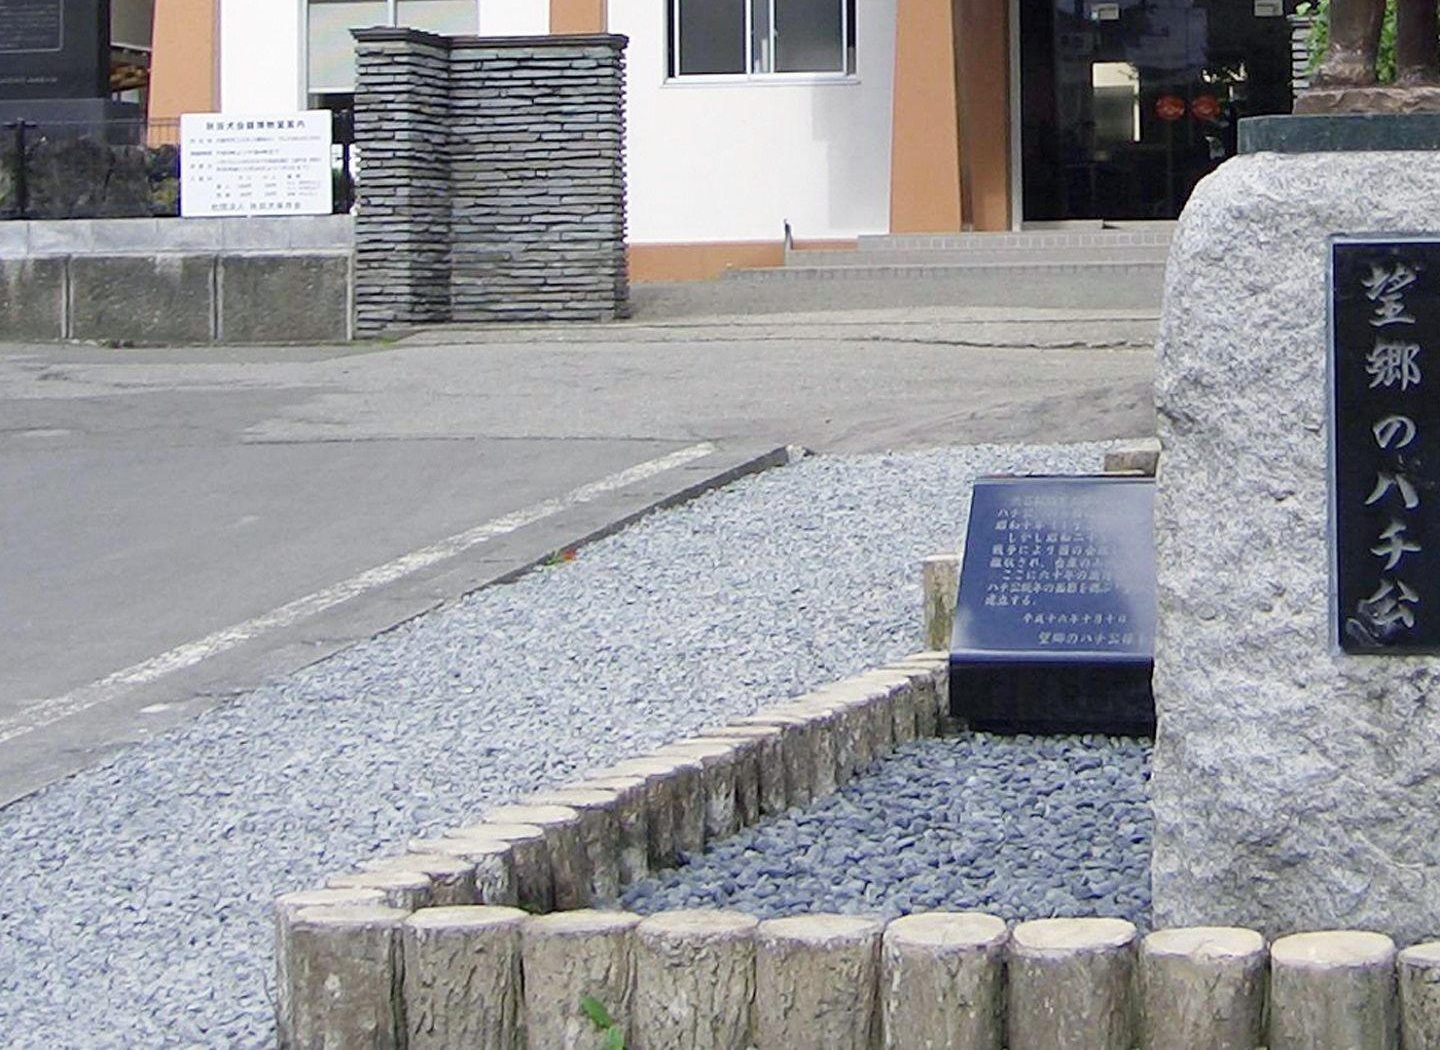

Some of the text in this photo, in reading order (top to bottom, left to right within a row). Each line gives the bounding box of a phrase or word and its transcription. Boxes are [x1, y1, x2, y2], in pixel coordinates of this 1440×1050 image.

[1357, 262, 1422, 629] 望郷のハチ公
